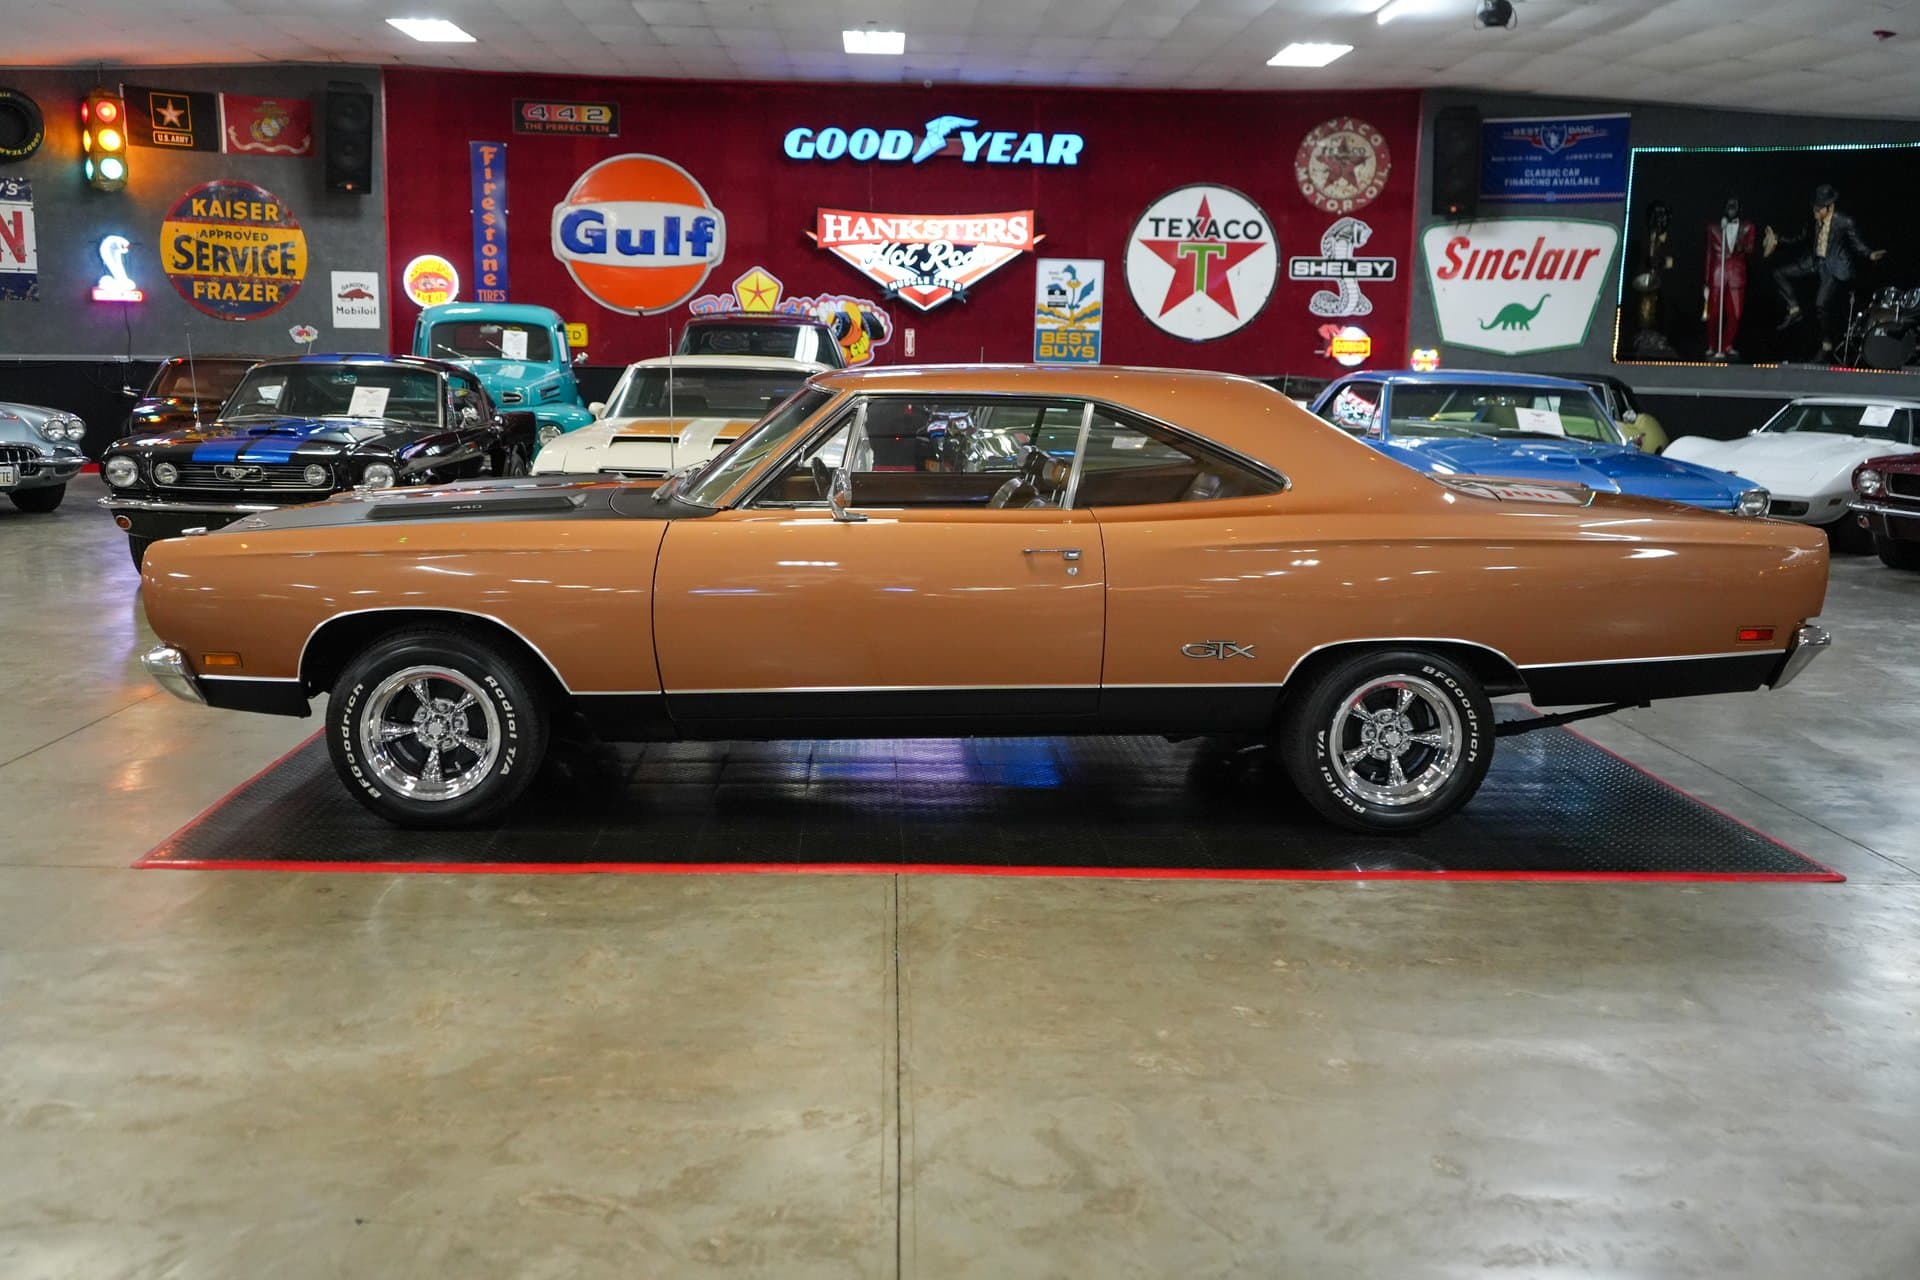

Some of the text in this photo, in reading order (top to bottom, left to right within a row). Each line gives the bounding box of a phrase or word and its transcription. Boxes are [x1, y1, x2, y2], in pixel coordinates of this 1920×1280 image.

[524, 122, 609, 133] THE PERFECT TEN
[157, 134, 189, 145] U.S. ARMY
[1504, 177, 1601, 187] FINANCING AVAILABLE
[1524, 168, 1580, 177] CLASSIC CAR
[192, 197, 280, 222] KAISER
[479, 146, 499, 287] Firestone
[199, 229, 269, 242] APPROVED
[560, 209, 716, 257] Gulf
[822, 213, 1029, 246] HANKSTERS
[1149, 217, 1263, 240] TEXACO
[173, 234, 297, 276] SERVICE
[861, 239, 992, 272] Hot Rod
[1437, 235, 1601, 281] Sinclair
[1177, 243, 1227, 293] T
[1293, 261, 1390, 277] SHELBY
[193, 280, 280, 303] FRAZER
[477, 289, 506, 302] TIRES
[889, 276, 963, 292] MUSCLE CARS
[336, 306, 377, 315] Mobiloil
[1041, 331, 1094, 345] BEST
[1039, 344, 1096, 358] BUYS
[1181, 639, 1256, 660] GTX
[484, 675, 518, 776] Radial T/A
[1421, 665, 1478, 763] BFGoodrich
[340, 682, 382, 799] BFGoodrich
[1317, 730, 1367, 814] Radial T/A
